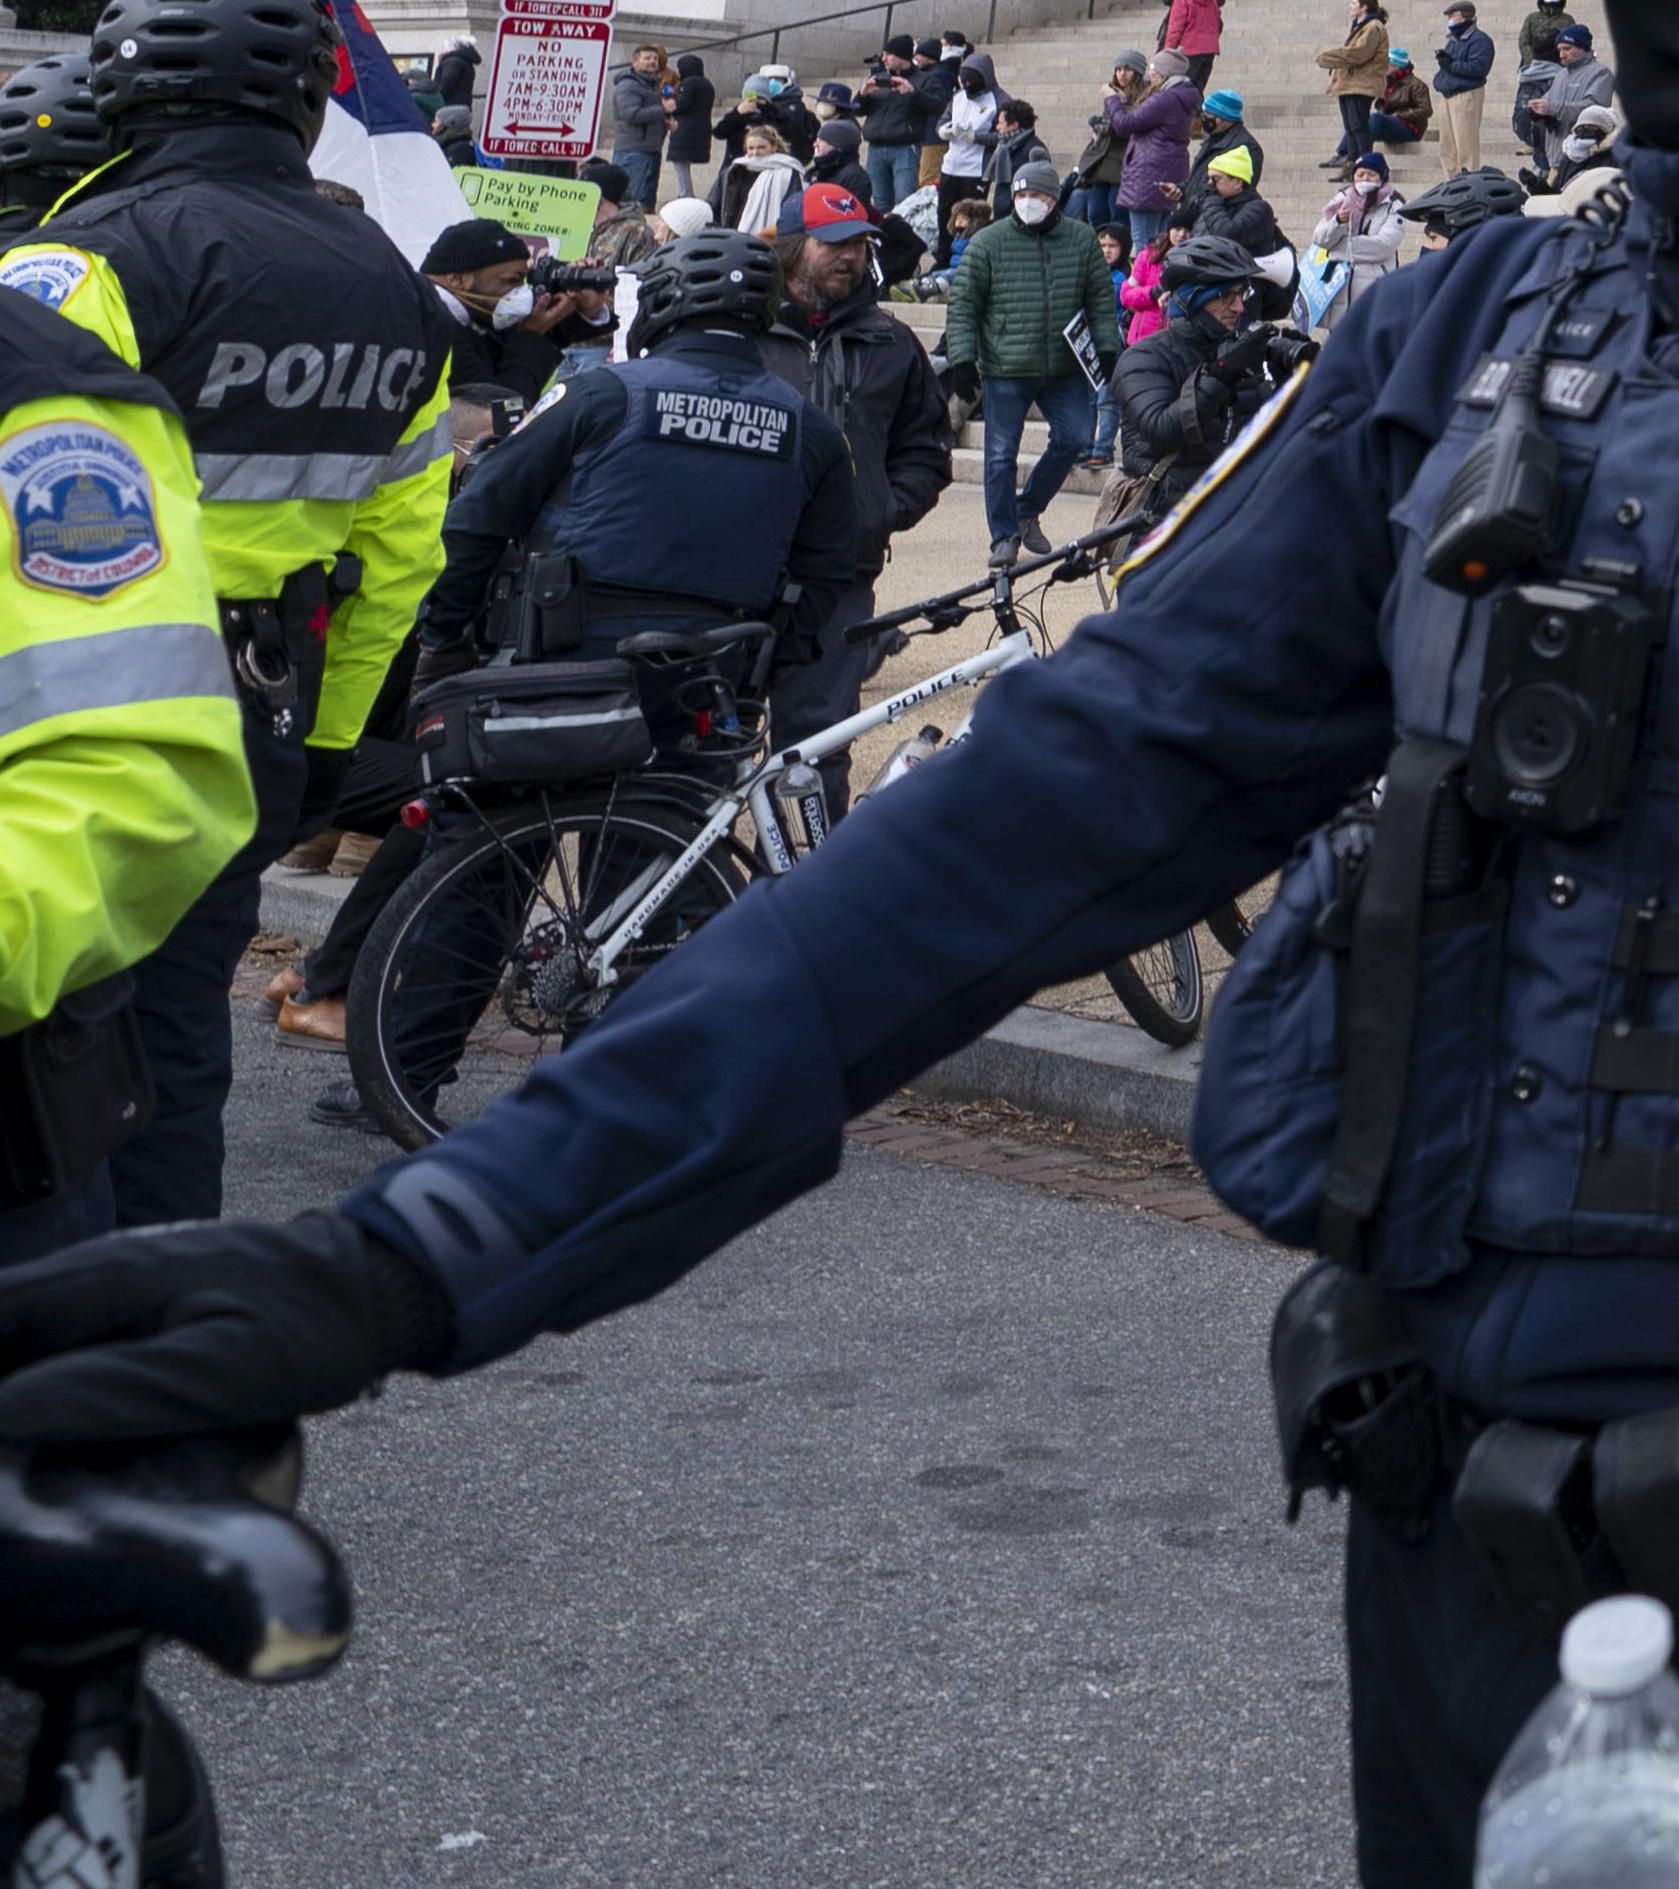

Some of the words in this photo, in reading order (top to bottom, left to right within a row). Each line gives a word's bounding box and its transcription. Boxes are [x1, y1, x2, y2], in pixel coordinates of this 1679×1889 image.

[514, 1, 523, 12] IF
[562, 5, 585, 16] CALL
[513, 21, 546, 33] TOW
[549, 23, 596, 37] AWAY
[537, 40, 562, 54] NO
[516, 54, 584, 69] PARKING
[512, 70, 526, 80] OR
[529, 70, 587, 84] STANDING
[507, 82, 587, 98] 7AM-9:30AM
[503, 97, 583, 114] 4PM-6:30PM
[489, 140, 500, 152] IF
[541, 143, 566, 154] CALL
[570, 144, 586, 156] 311
[488, 178, 514, 194] Pay
[518, 181, 536, 197] by
[540, 185, 587, 202] Phone
[484, 192, 540, 213] Parking
[656, 391, 788, 432] METROPOLITAN
[660, 413, 781, 452] POLICE
[887, 668, 965, 716] POLICE
